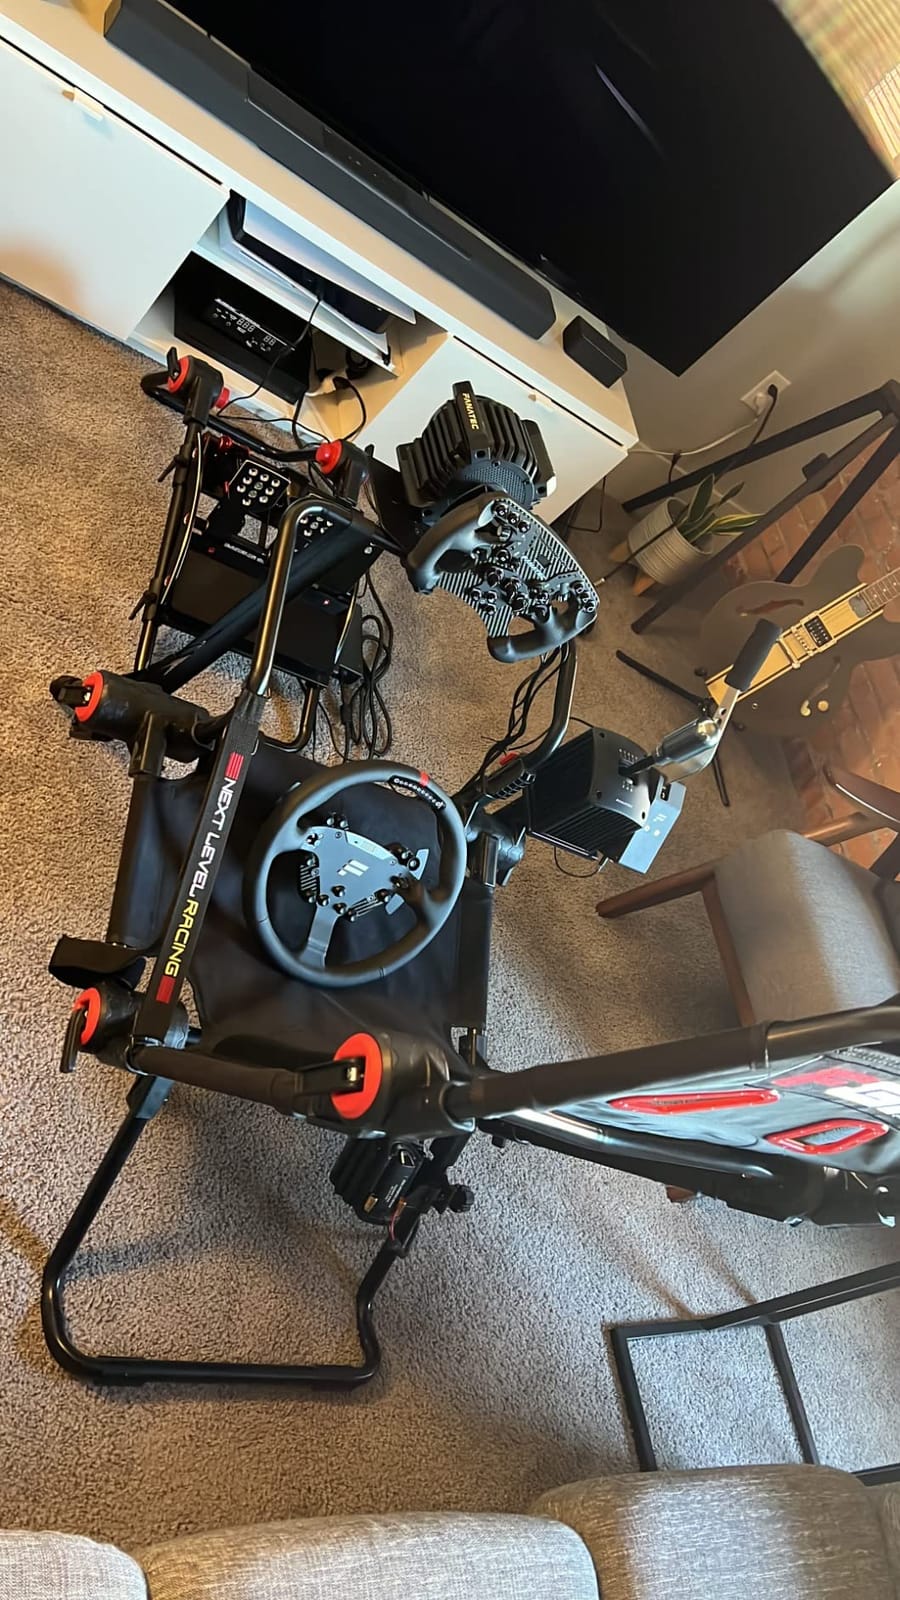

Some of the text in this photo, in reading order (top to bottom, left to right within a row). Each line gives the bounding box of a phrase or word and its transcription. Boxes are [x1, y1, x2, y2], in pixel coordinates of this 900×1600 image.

[462, 393, 479, 430] FANATEC
[164, 777, 237, 977] NEXT LEVEL RACING
